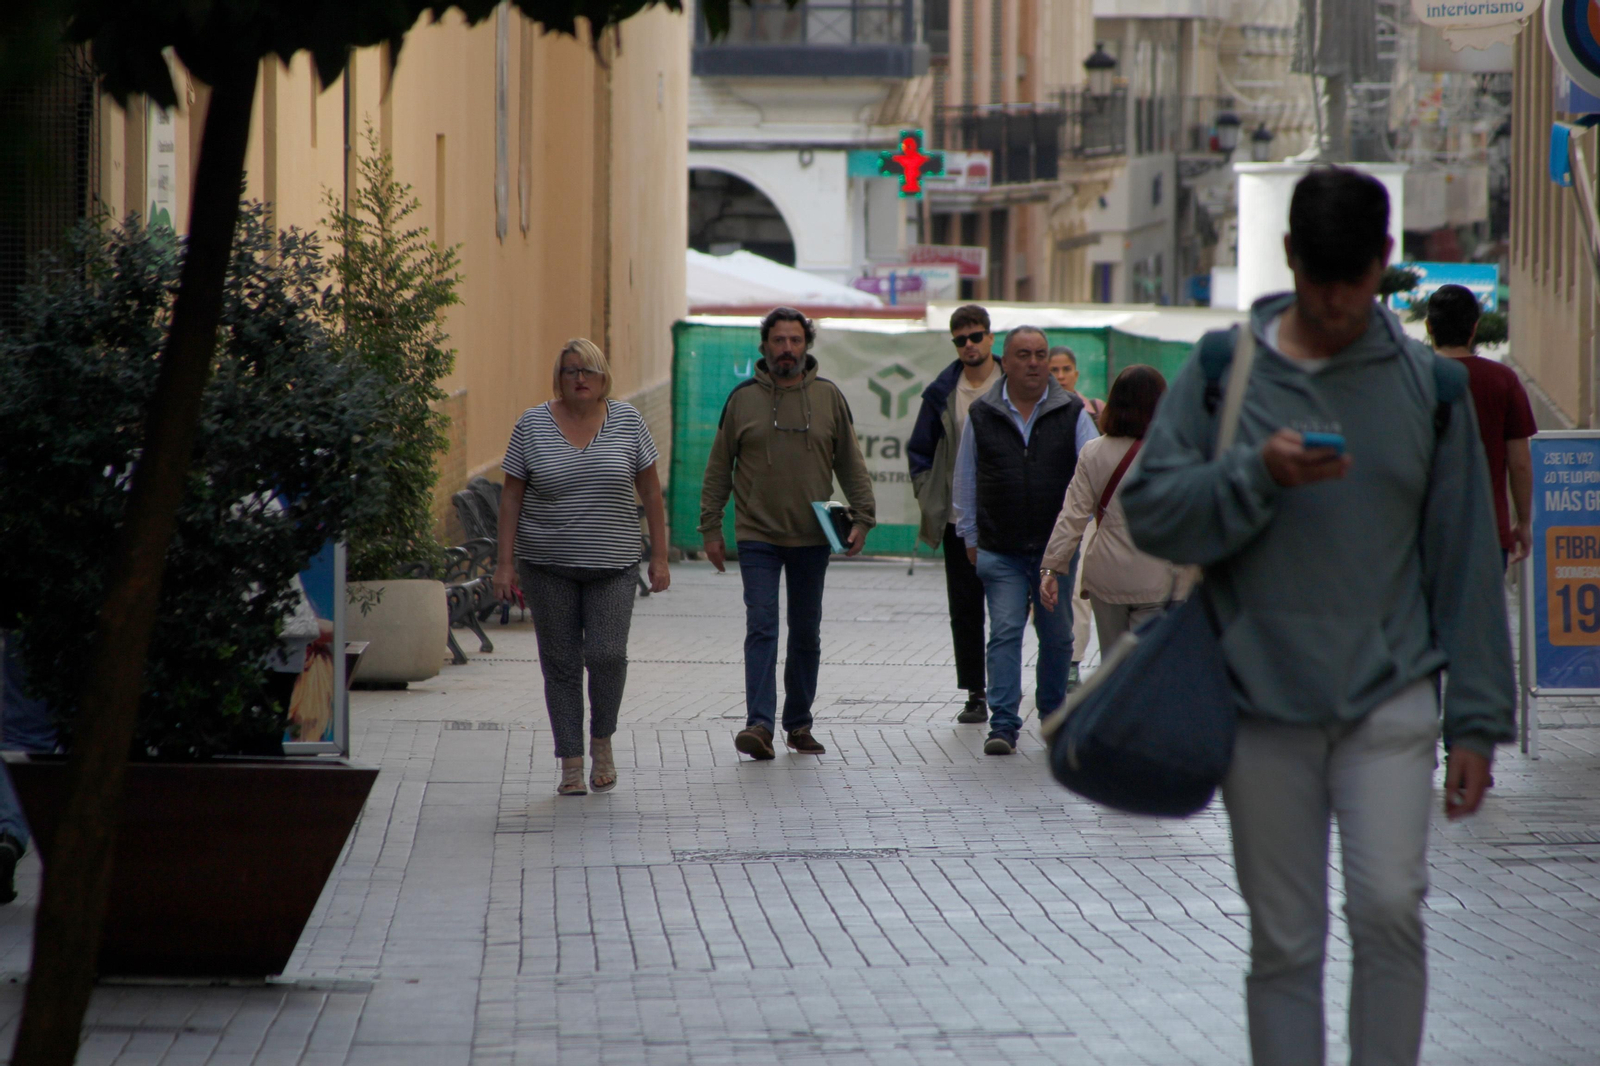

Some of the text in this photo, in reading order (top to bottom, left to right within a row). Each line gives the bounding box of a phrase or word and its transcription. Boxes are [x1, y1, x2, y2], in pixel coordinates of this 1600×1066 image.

[1426, 1, 1524, 18] interiorismo
[1544, 452, 1594, 465] ¿SE VE YA?
[1544, 471, 1557, 484] ¿O
[1557, 471, 1570, 484] TE
[1570, 471, 1583, 484] LO
[1545, 487, 1582, 511] MÁS
[1555, 536, 1600, 559] FIBR
